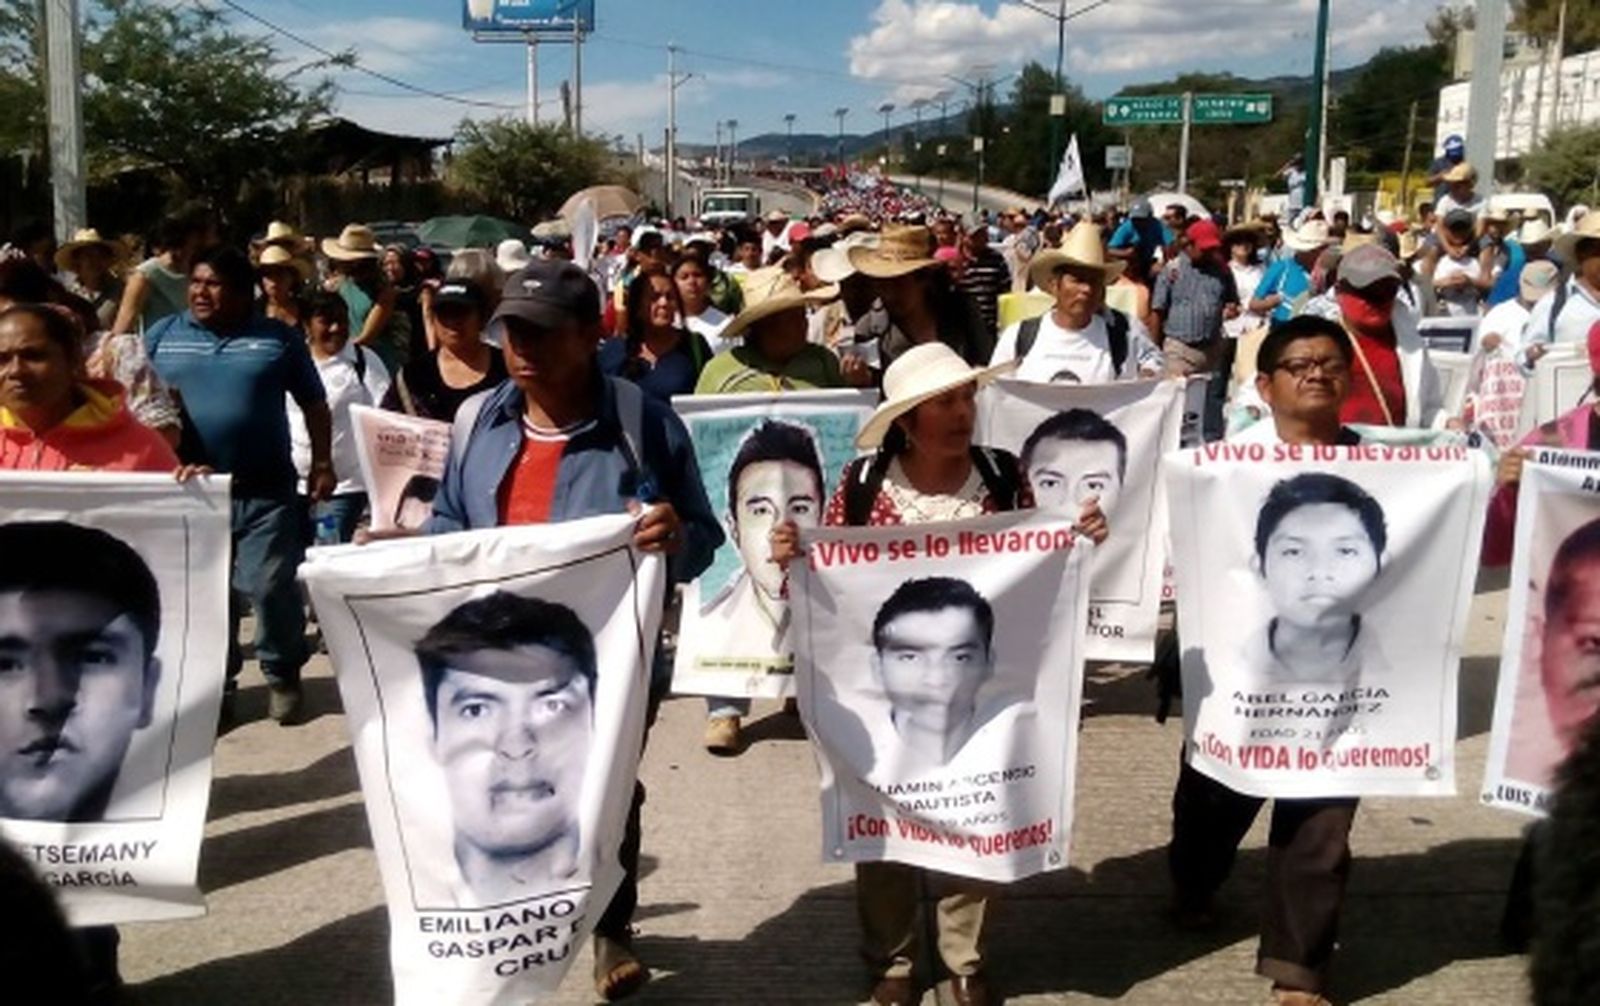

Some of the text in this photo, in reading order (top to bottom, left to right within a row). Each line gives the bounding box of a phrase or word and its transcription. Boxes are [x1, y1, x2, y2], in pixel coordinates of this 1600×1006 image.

[1274, 444, 1302, 461] se
[1314, 442, 1337, 461] lo
[809, 541, 879, 573] ¡Vivo
[888, 541, 917, 561] se
[926, 534, 950, 557] lo
[1240, 746, 1290, 770] VIDA
[1298, 746, 1318, 770] lo
[1322, 742, 1430, 771] queremos!
[1497, 784, 1531, 806] LUIS
[848, 814, 890, 841] ¡Con
[419, 899, 575, 934] EMILIANO
[427, 926, 557, 958] GASPAR
[495, 943, 569, 976] CRU
